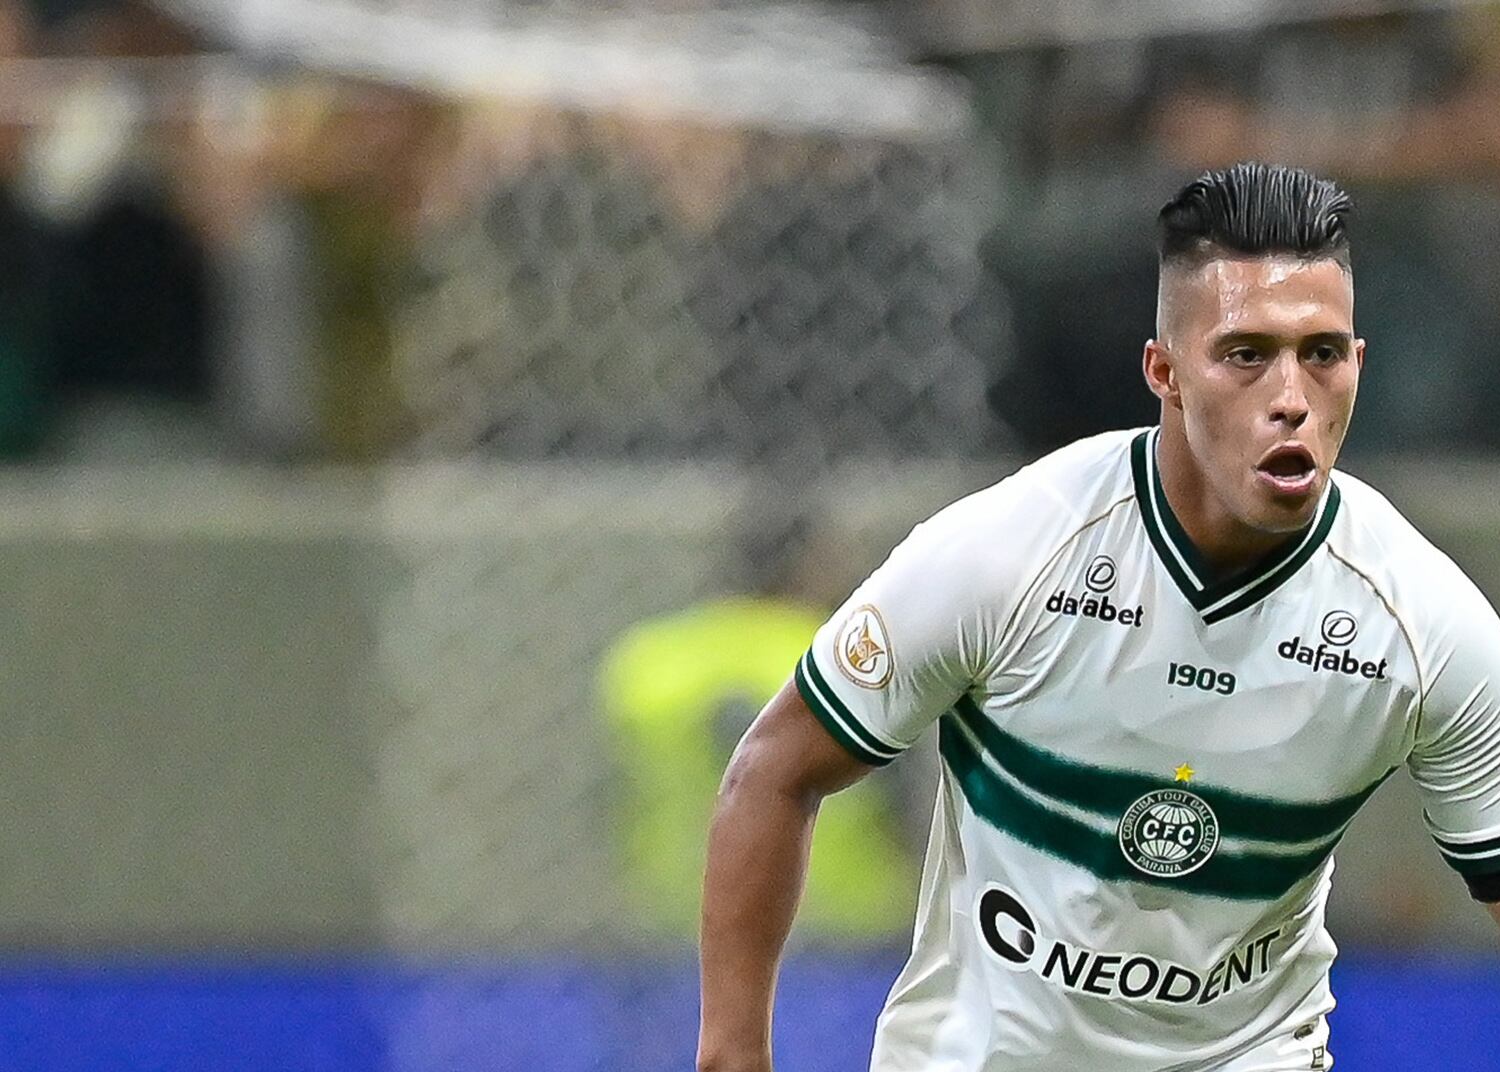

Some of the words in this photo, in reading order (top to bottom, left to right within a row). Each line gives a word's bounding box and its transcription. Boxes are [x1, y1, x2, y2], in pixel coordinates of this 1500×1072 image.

[1167, 661, 1236, 695] 1909
[1278, 636, 1388, 680] dafabet
[1142, 819, 1195, 846] CFC
[1190, 797, 1211, 823] BALL
[1201, 824, 1215, 853] CLUB
[1041, 928, 1282, 1006] NEODENT
